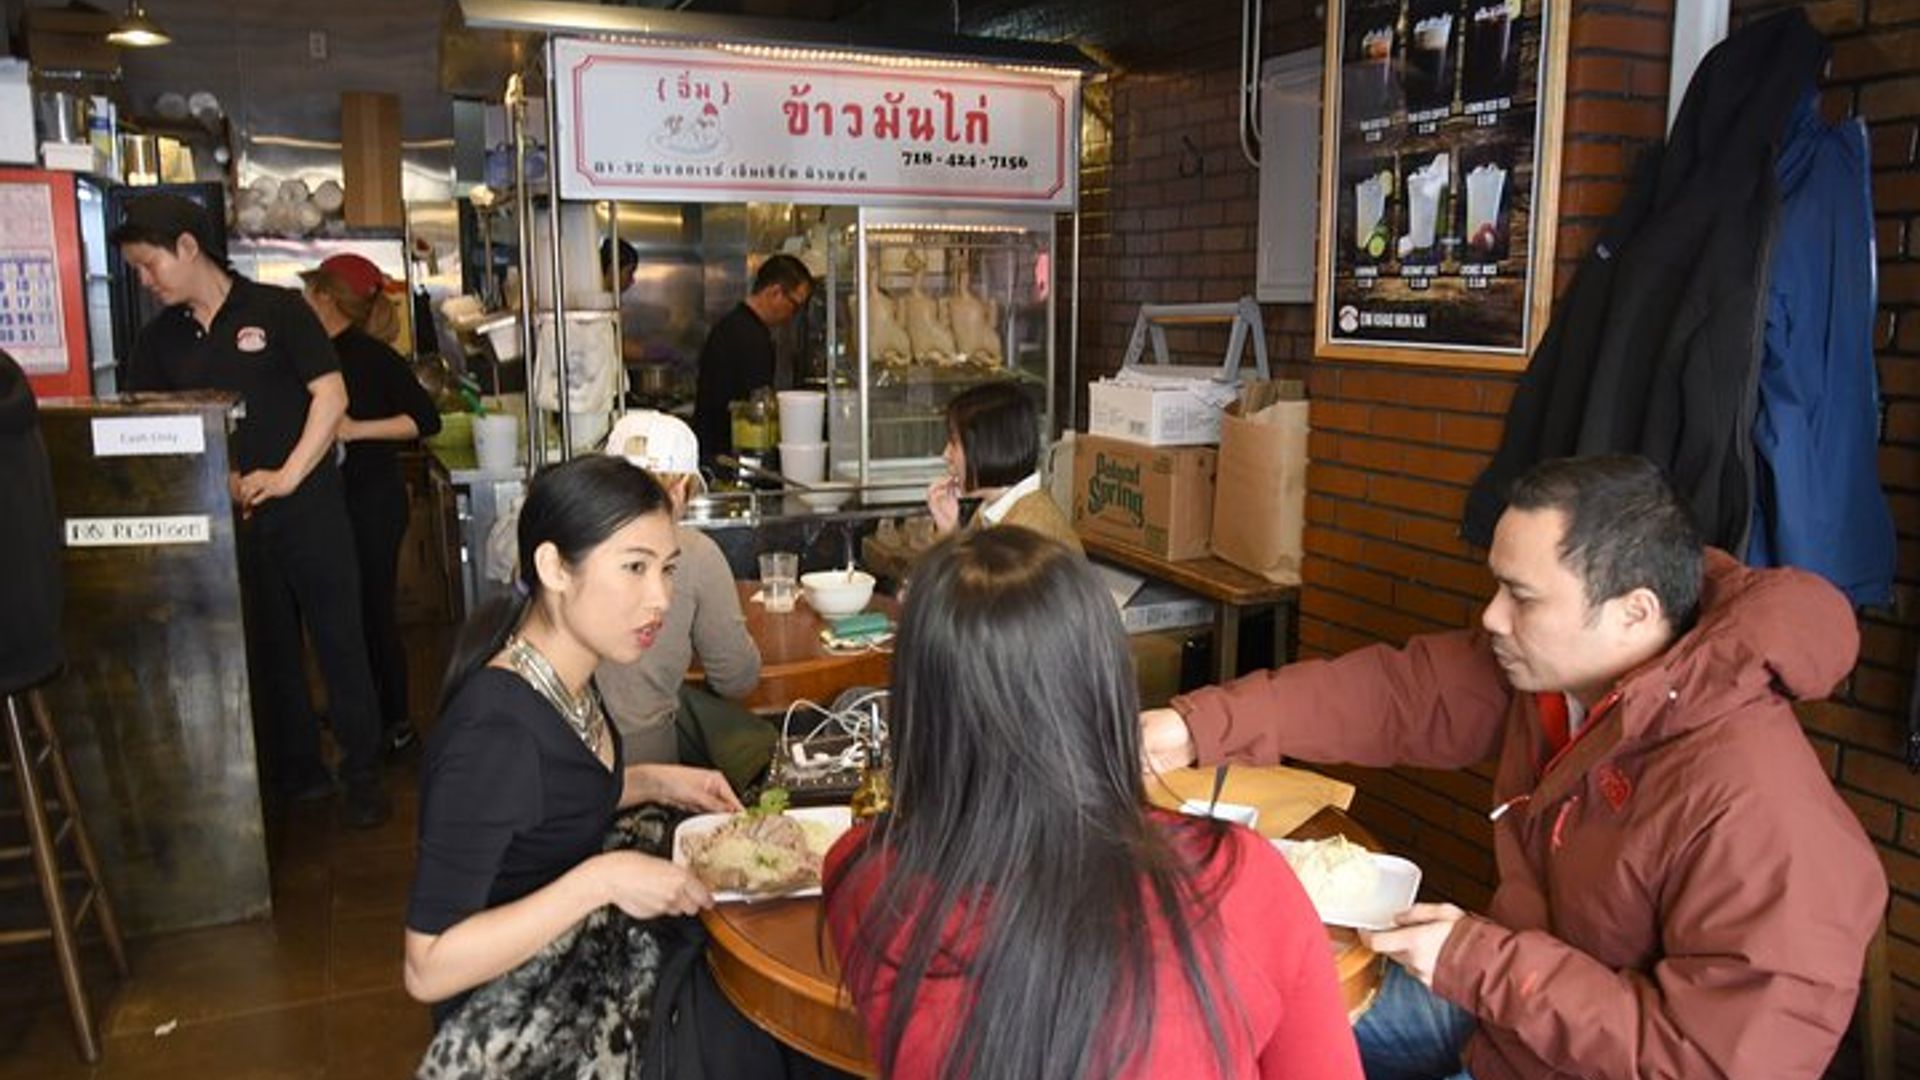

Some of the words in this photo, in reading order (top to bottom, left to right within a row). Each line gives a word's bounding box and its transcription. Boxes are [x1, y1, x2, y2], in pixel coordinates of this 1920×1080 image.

[782, 83, 990, 145] ข้าวมันไก่
[1096, 452, 1140, 487] Poland
[1088, 475, 1145, 530] Spring
